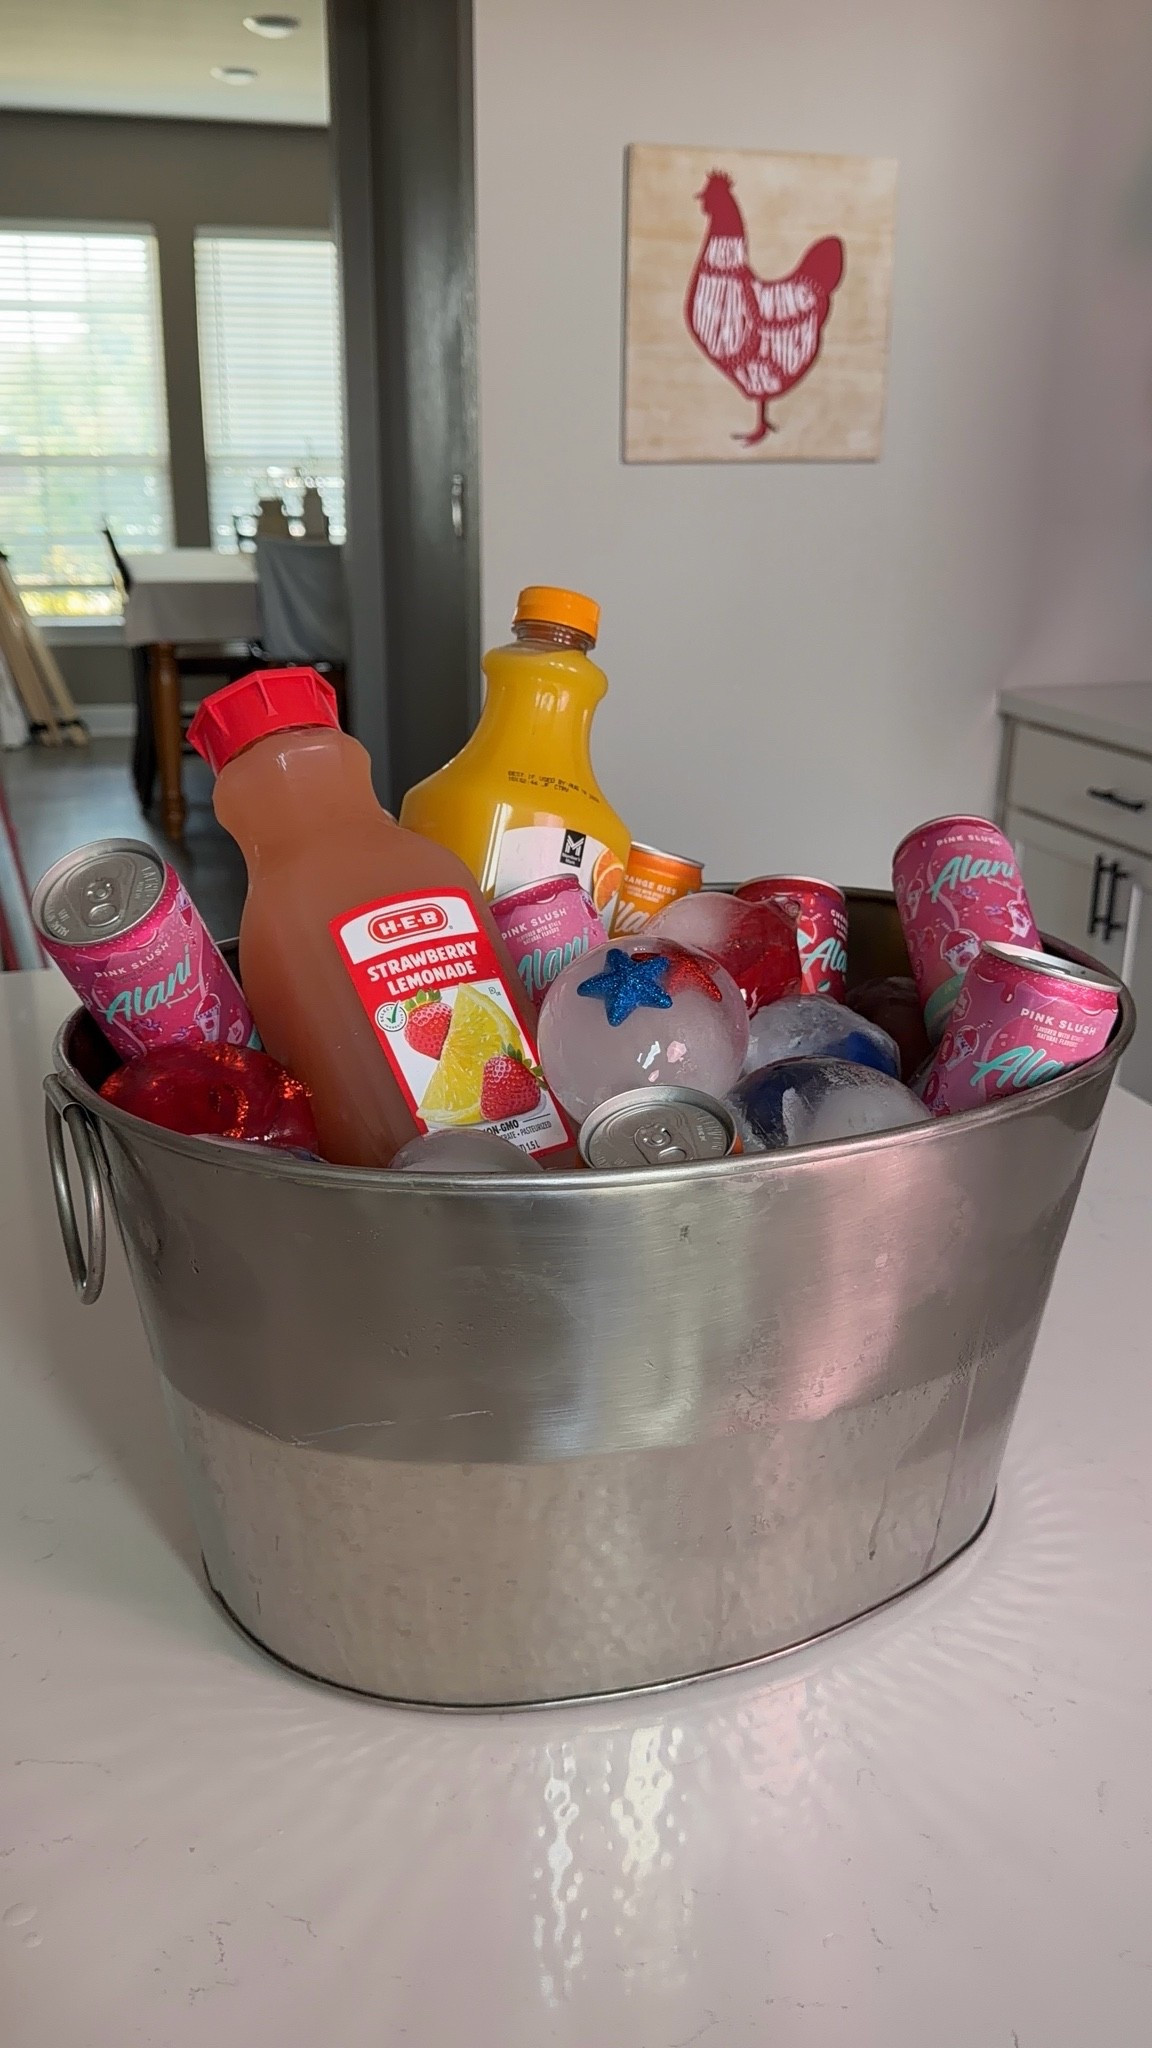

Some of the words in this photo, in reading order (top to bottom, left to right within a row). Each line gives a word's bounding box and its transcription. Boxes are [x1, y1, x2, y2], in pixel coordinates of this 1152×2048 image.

[936, 835, 963, 846] PINK
[624, 874, 654, 890] RANGE
[378, 910, 438, 936] H-E-B
[501, 923, 528, 940] PINK
[530, 907, 567, 927] SLUSH
[94, 967, 127, 978] PINK
[131, 941, 169, 970] SLUSH
[367, 941, 477, 982] STRAWBERRY
[97, 943, 191, 1025] Alani
[387, 961, 477, 996] LEMONADE
[1020, 1008, 1055, 1026] PINK
[1059, 1019, 1097, 1036] SLUSH
[483, 1119, 519, 1135] ON-GMO
[520, 1121, 552, 1136] PASTEURIZED
